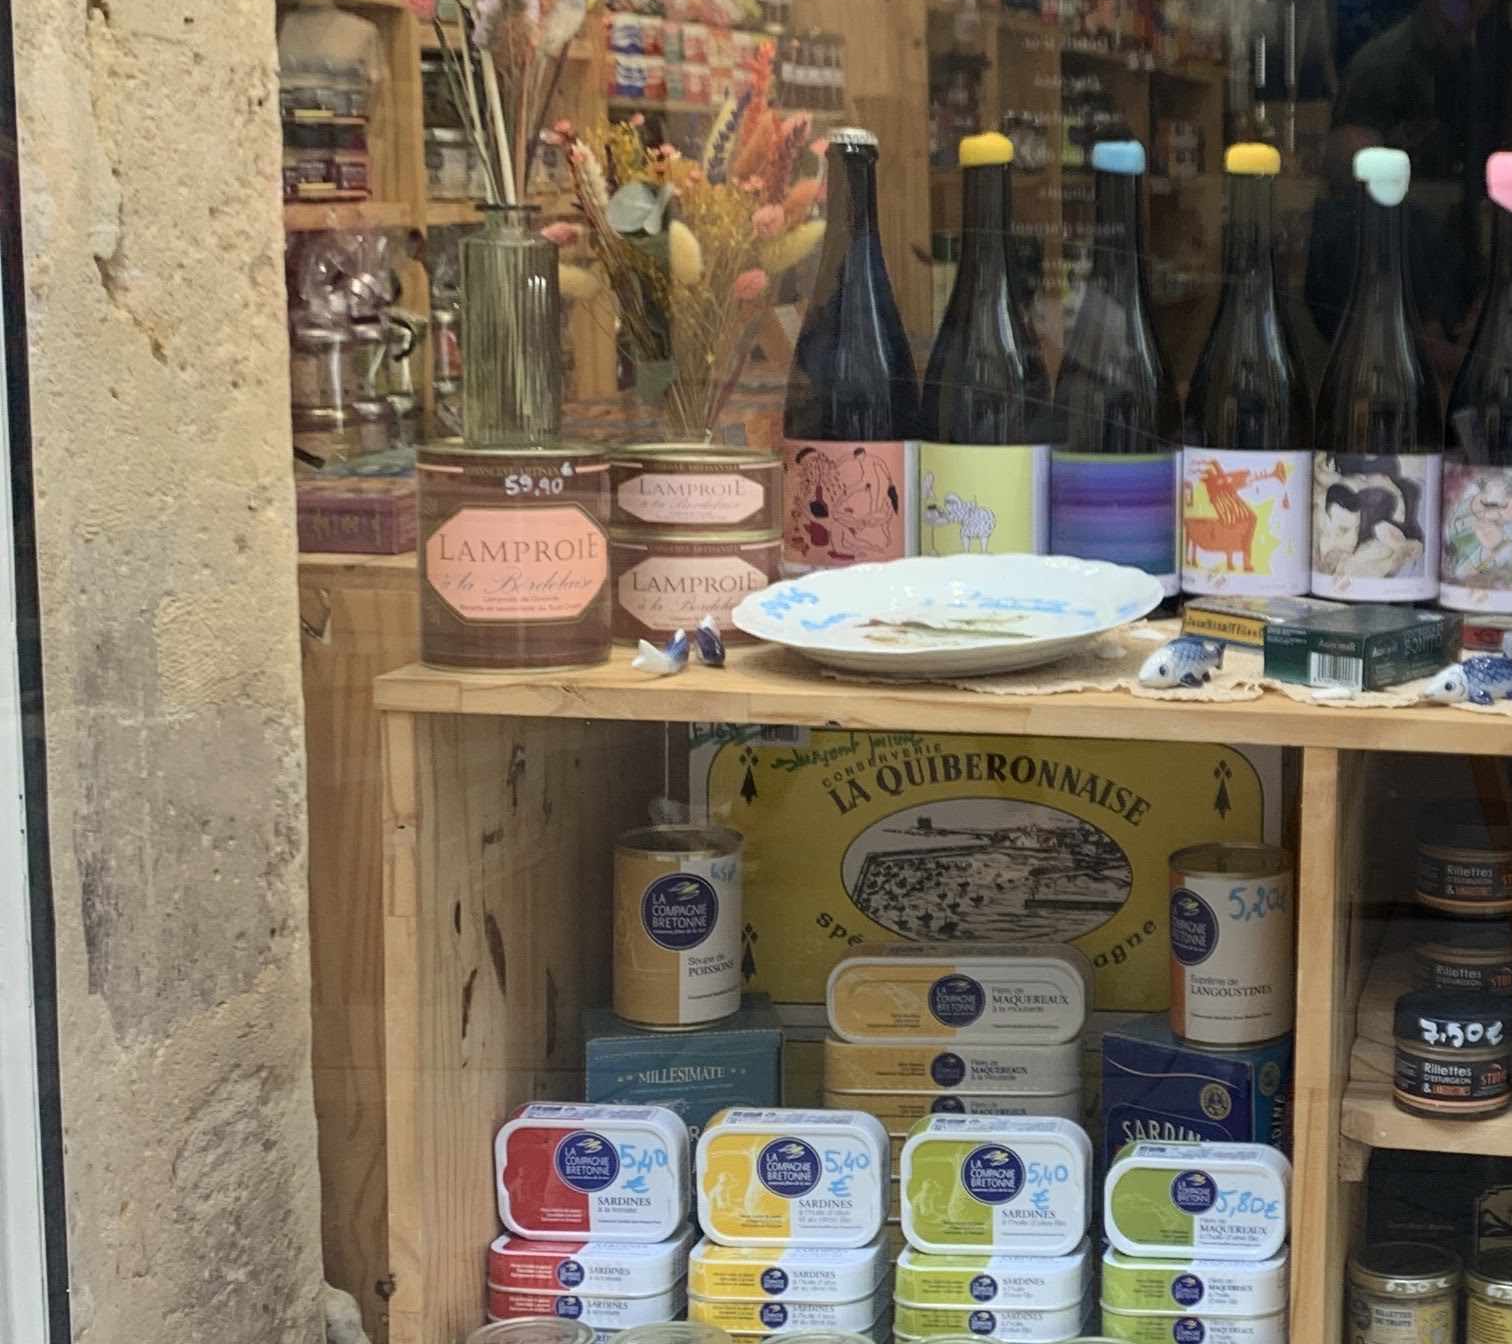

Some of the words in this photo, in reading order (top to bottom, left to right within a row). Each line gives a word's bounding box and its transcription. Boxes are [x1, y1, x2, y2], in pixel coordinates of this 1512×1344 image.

[439, 533, 599, 563] LAMPROIE
[633, 571, 757, 593] LAMPROIE
[823, 743, 943, 789] CONSERVERIE
[828, 776, 872, 816] LA
[875, 753, 1152, 827] QUIBERONNAISE
[1447, 864, 1494, 879] Rillettes
[653, 893, 666, 904] LA
[652, 905, 708, 917] COMPAGNIE
[652, 916, 708, 928] BRETONNE
[1436, 965, 1482, 980] Rillettes
[1190, 984, 1273, 998] LANGOUSTINES
[992, 995, 1069, 1006] MAQUEREAUX
[638, 1066, 726, 1083] MILLESIMATE
[1424, 1063, 1473, 1078] Rillettes
[565, 1147, 576, 1156] LA
[565, 1156, 610, 1167] COMPAGNIE
[766, 1153, 778, 1162] LA
[766, 1162, 812, 1172] COMPAGNIE
[971, 1159, 981, 1169] LA
[565, 1165, 610, 1176] BRETONNE
[767, 1171, 812, 1181] BRETONNE
[970, 1168, 1015, 1179] COMPAGNIE
[1028, 1162, 1068, 1187] 5,40
[827, 1175, 854, 1198] €
[971, 1178, 1015, 1188] BRETONNE
[598, 1197, 651, 1206] SARDINES
[799, 1200, 853, 1208] SARDINES
[1030, 1189, 1049, 1211] €
[1002, 1209, 1056, 1219] SARDINES
[1200, 1225, 1267, 1235] MAQUEREAUX
[589, 1266, 630, 1276] SARDINES
[793, 1271, 835, 1279] SARDINES
